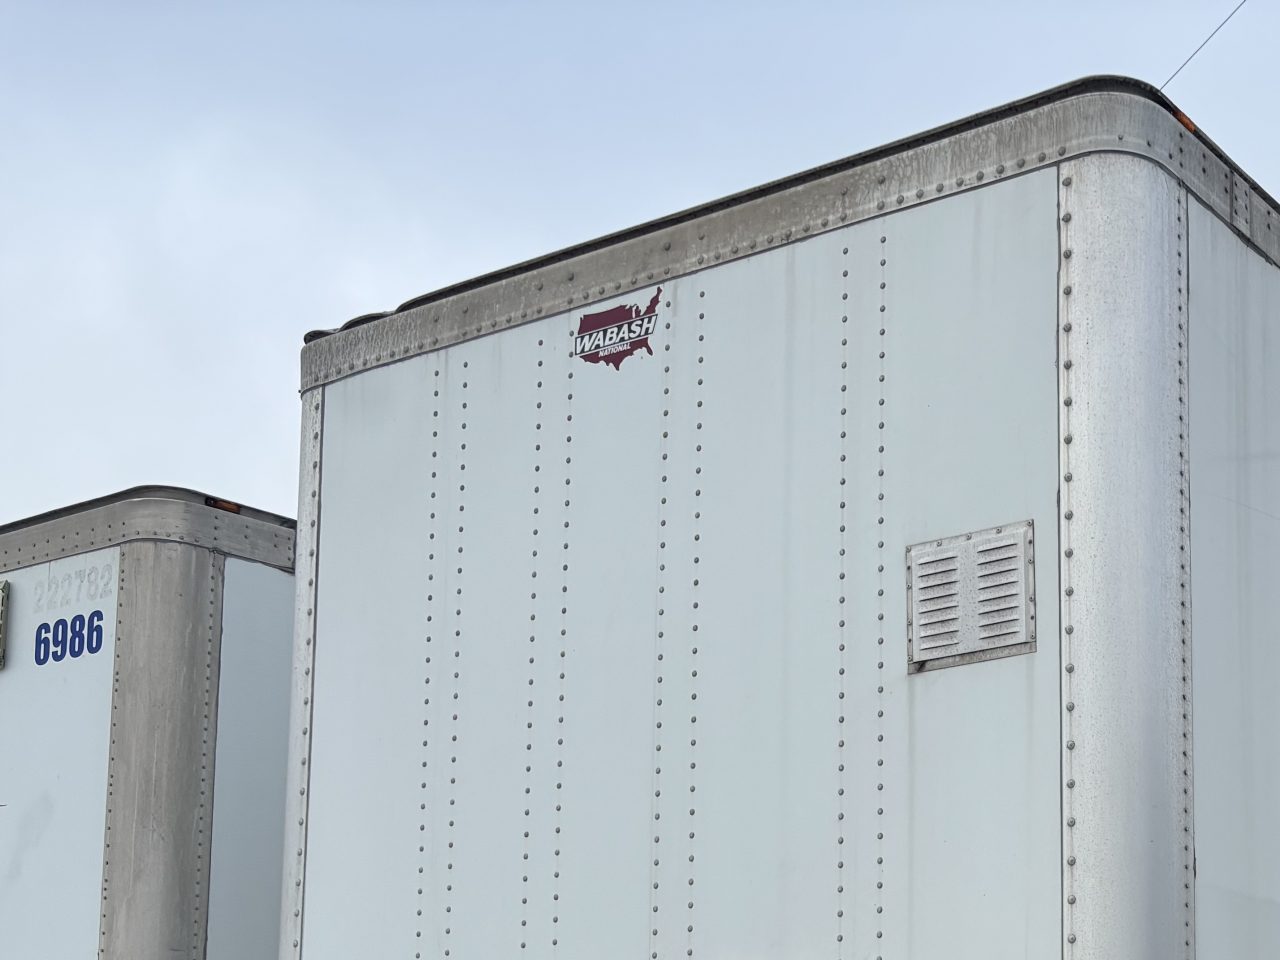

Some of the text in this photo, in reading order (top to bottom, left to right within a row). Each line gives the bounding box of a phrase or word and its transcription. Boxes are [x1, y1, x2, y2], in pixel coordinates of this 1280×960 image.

[576, 315, 657, 354] WABASH
[598, 342, 632, 358] NATIONAL
[34, 610, 104, 667] 6986
